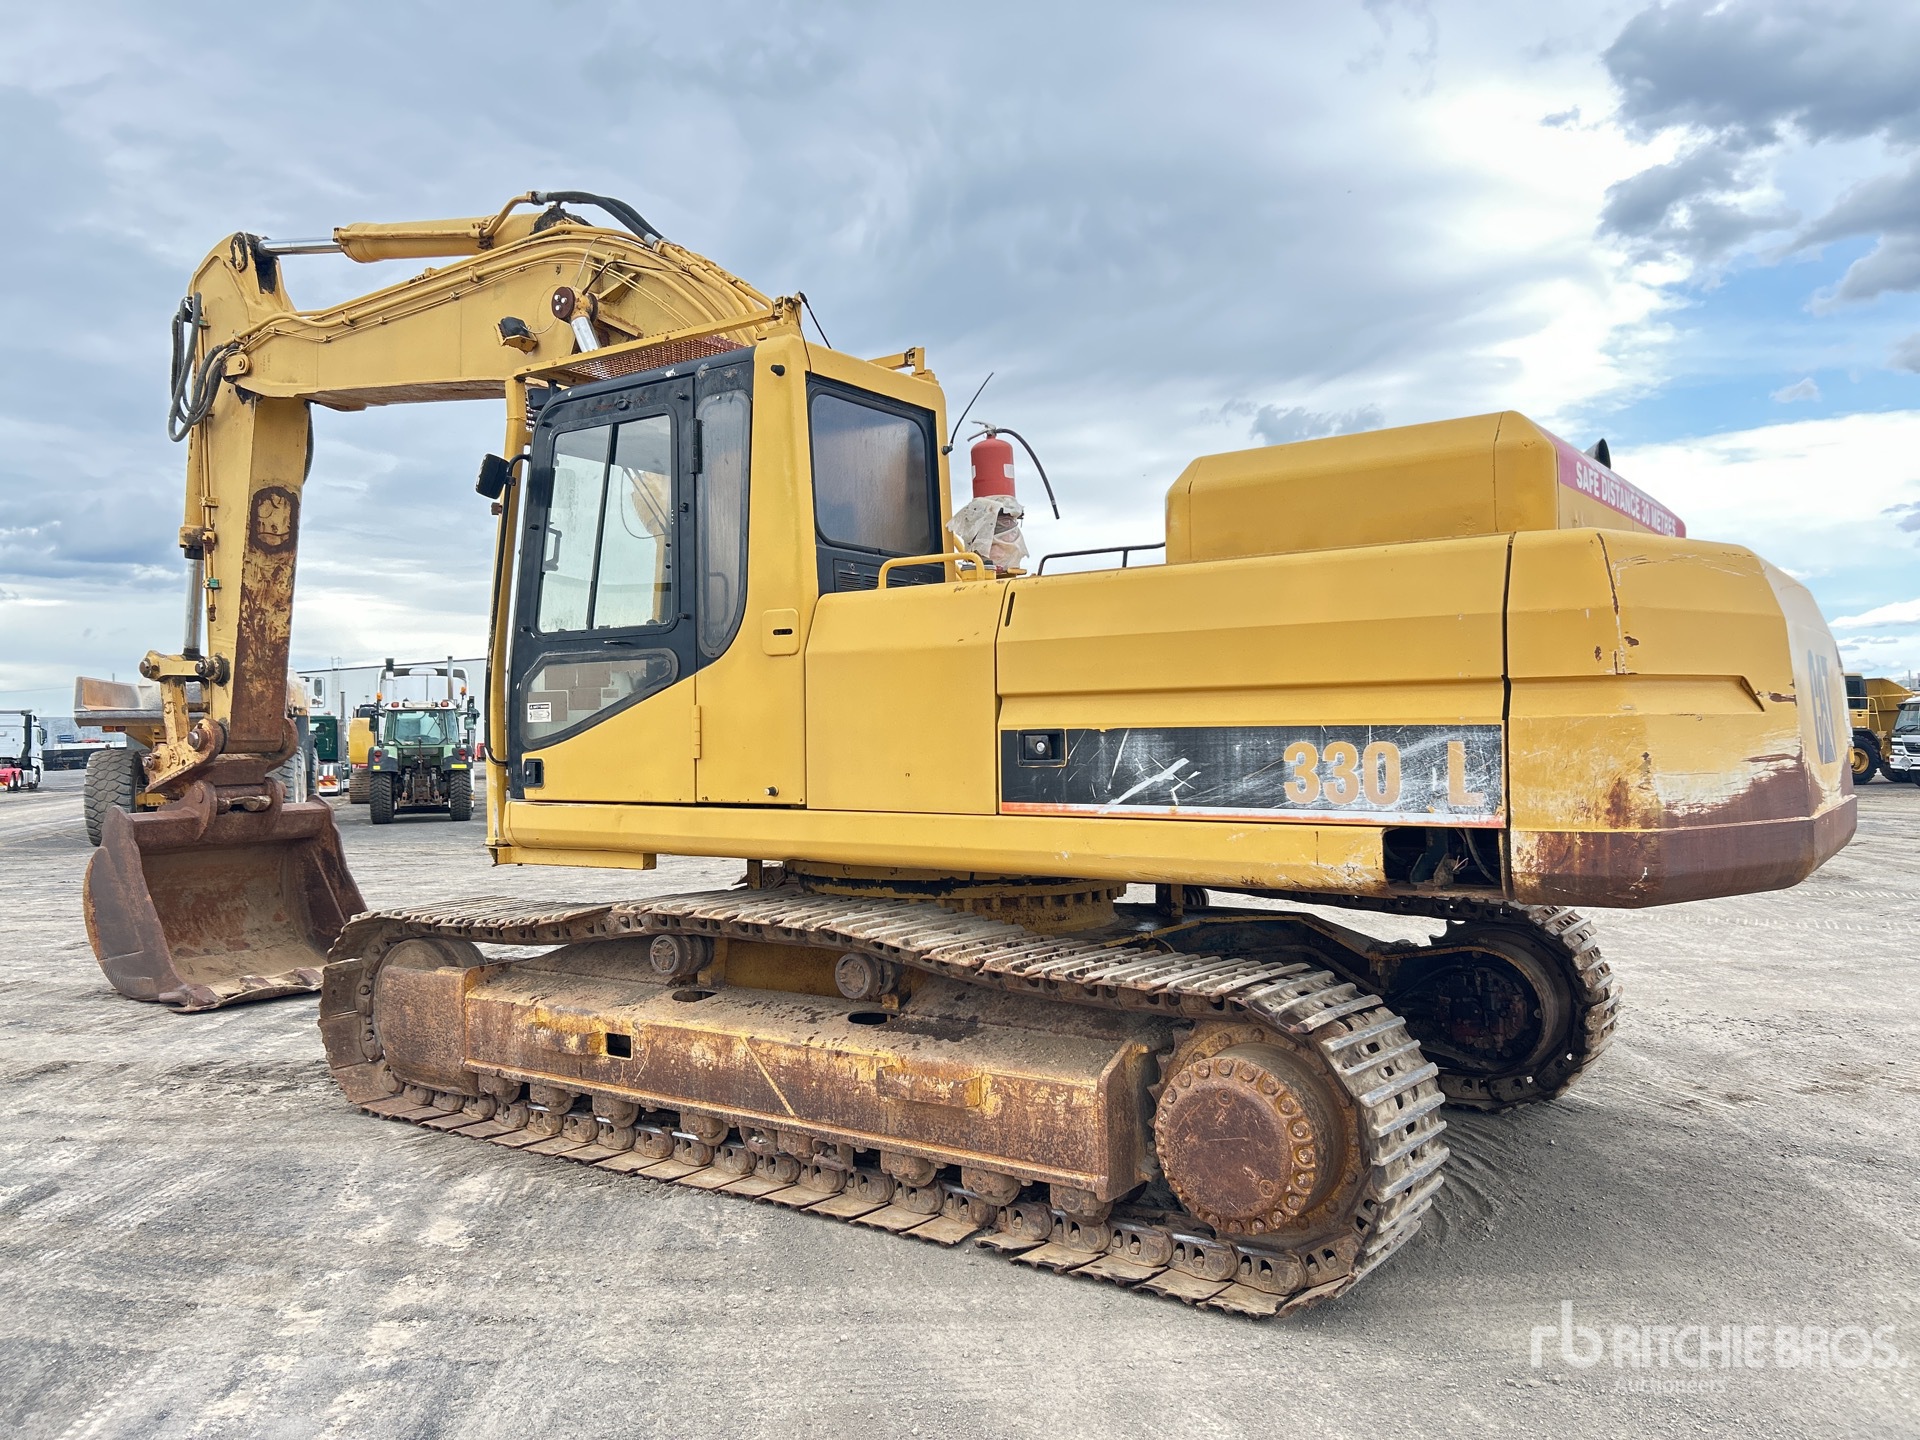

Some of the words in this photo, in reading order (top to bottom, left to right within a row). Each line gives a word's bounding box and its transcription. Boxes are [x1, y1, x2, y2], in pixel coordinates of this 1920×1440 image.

[1576, 461, 1600, 498] SAFE
[1601, 475, 1640, 520] DISTANCE
[1641, 501, 1650, 526] 30
[1651, 504, 1677, 538] METRES
[1283, 741, 1402, 806] 330
[1446, 740, 1484, 807] L
